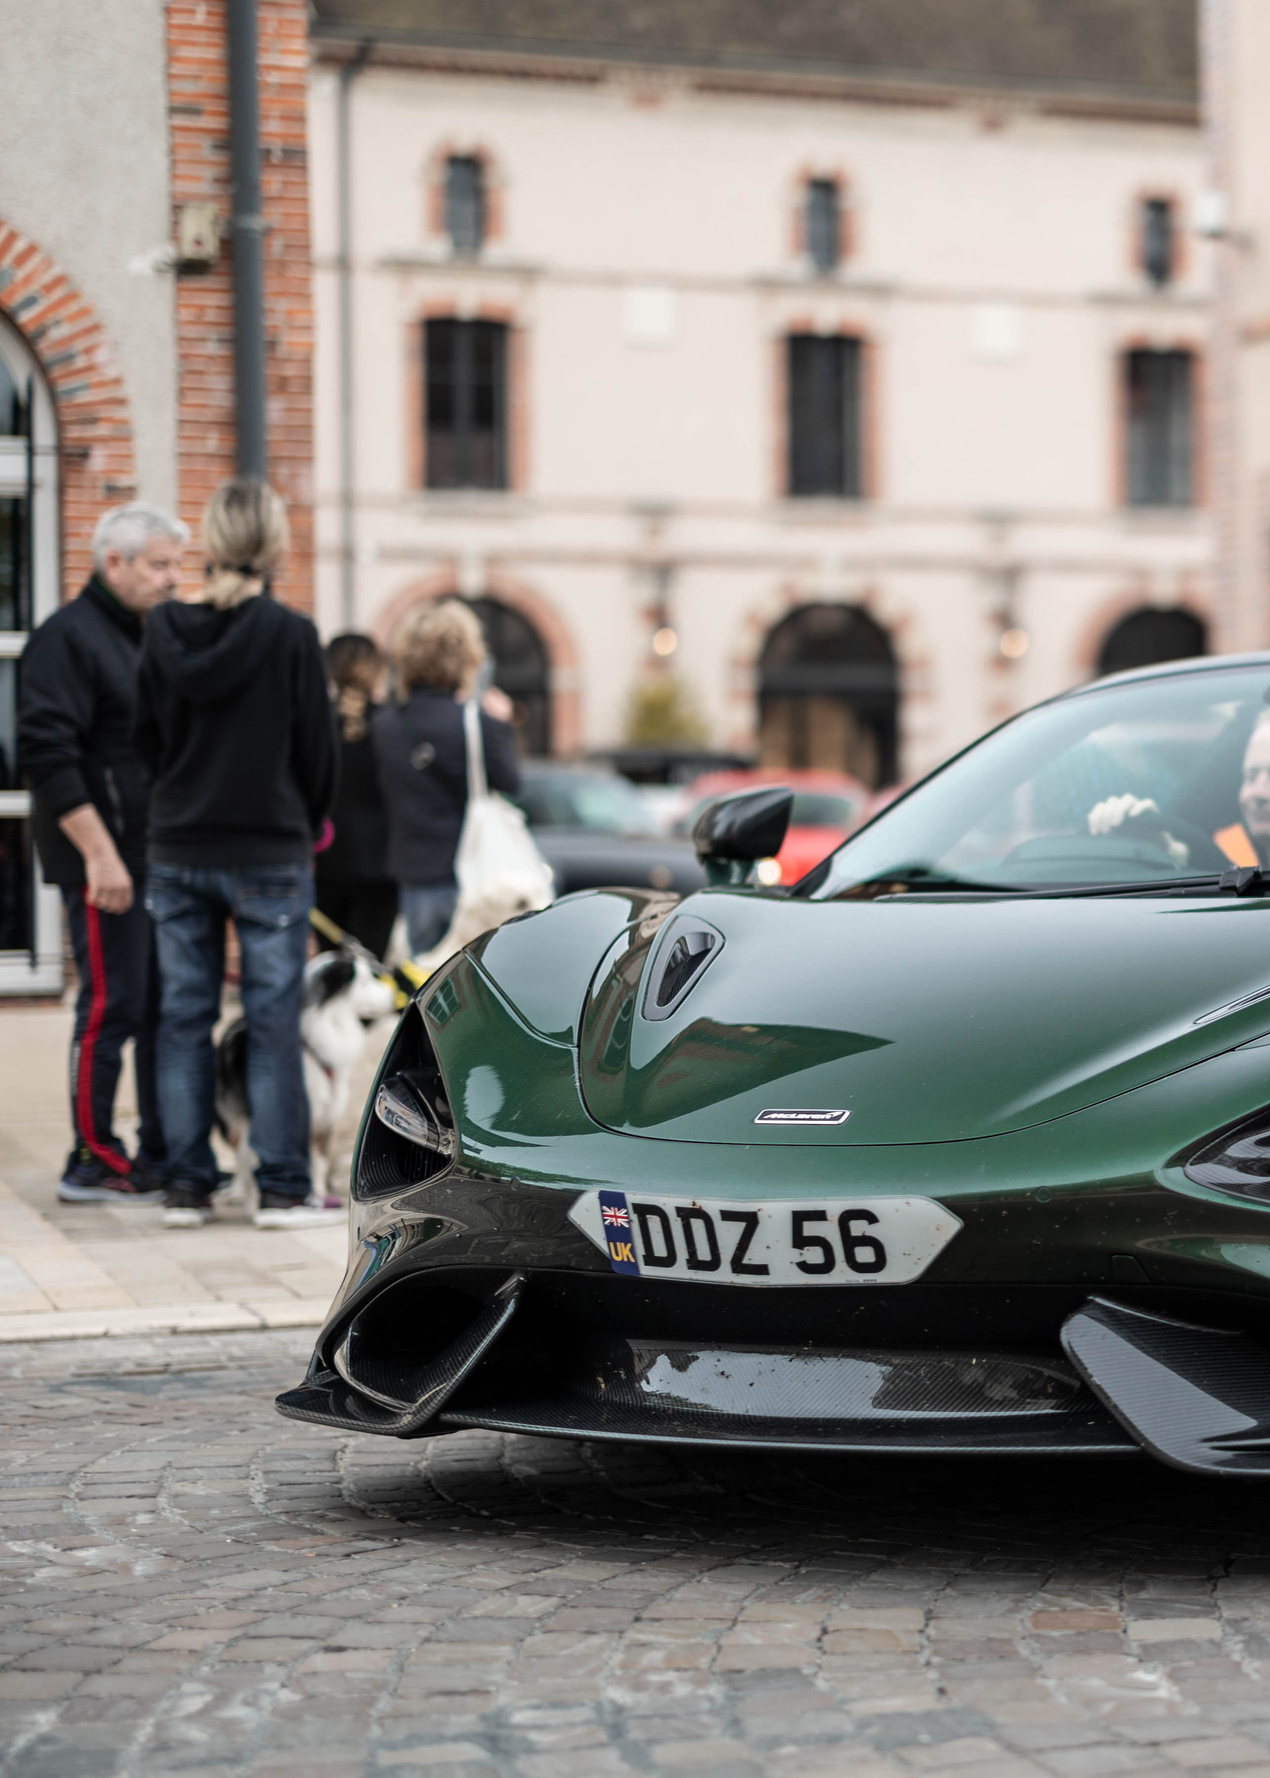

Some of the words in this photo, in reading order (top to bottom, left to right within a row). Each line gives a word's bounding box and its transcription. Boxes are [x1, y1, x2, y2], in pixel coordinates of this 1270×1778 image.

[609, 1241, 635, 1263] UK
[631, 1203, 770, 1276] DDZ
[791, 1208, 888, 1275] 56
